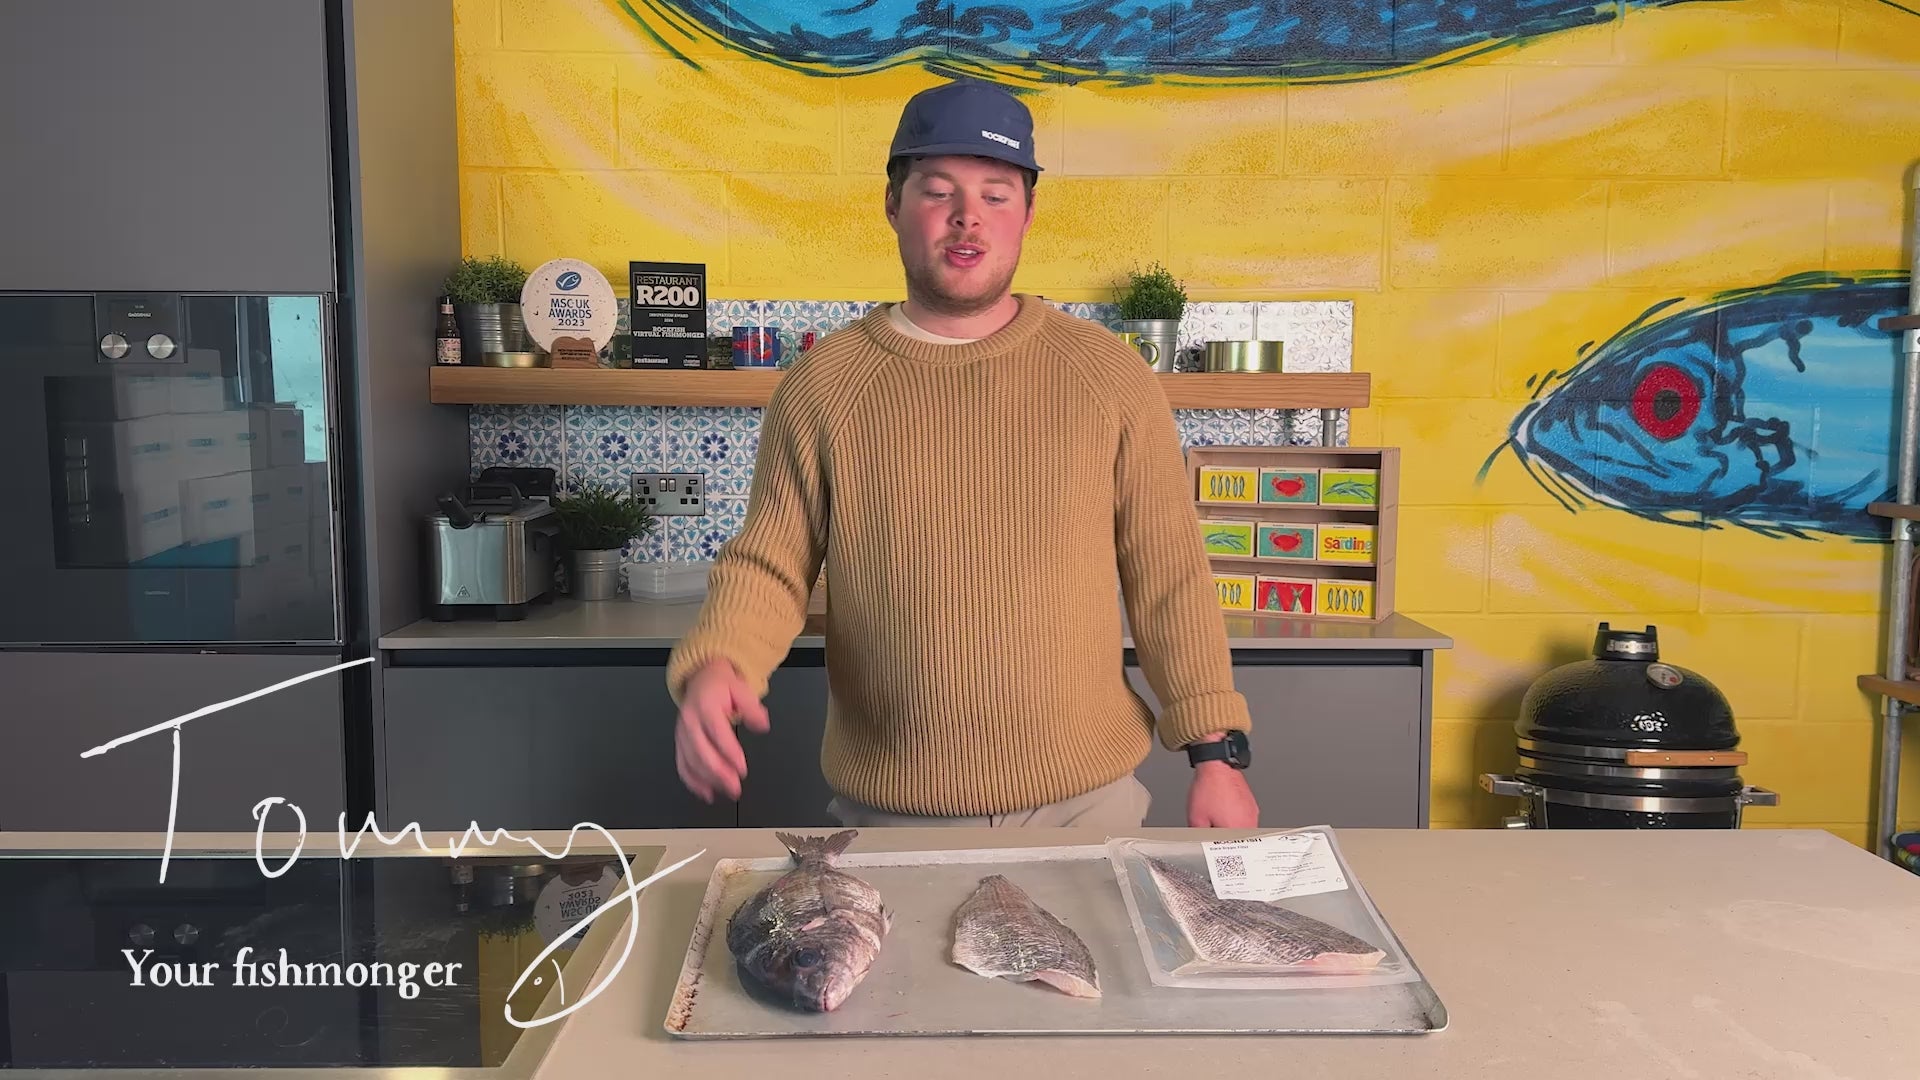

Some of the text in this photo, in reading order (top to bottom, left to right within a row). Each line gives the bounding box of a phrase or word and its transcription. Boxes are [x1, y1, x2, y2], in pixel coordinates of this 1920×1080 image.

[637, 276, 699, 286] RESTAURANT
[637, 285, 700, 306] R200
[550, 298, 590, 309] MSC UK
[548, 308, 592, 319] AWARDS
[558, 318, 585, 327] 2023
